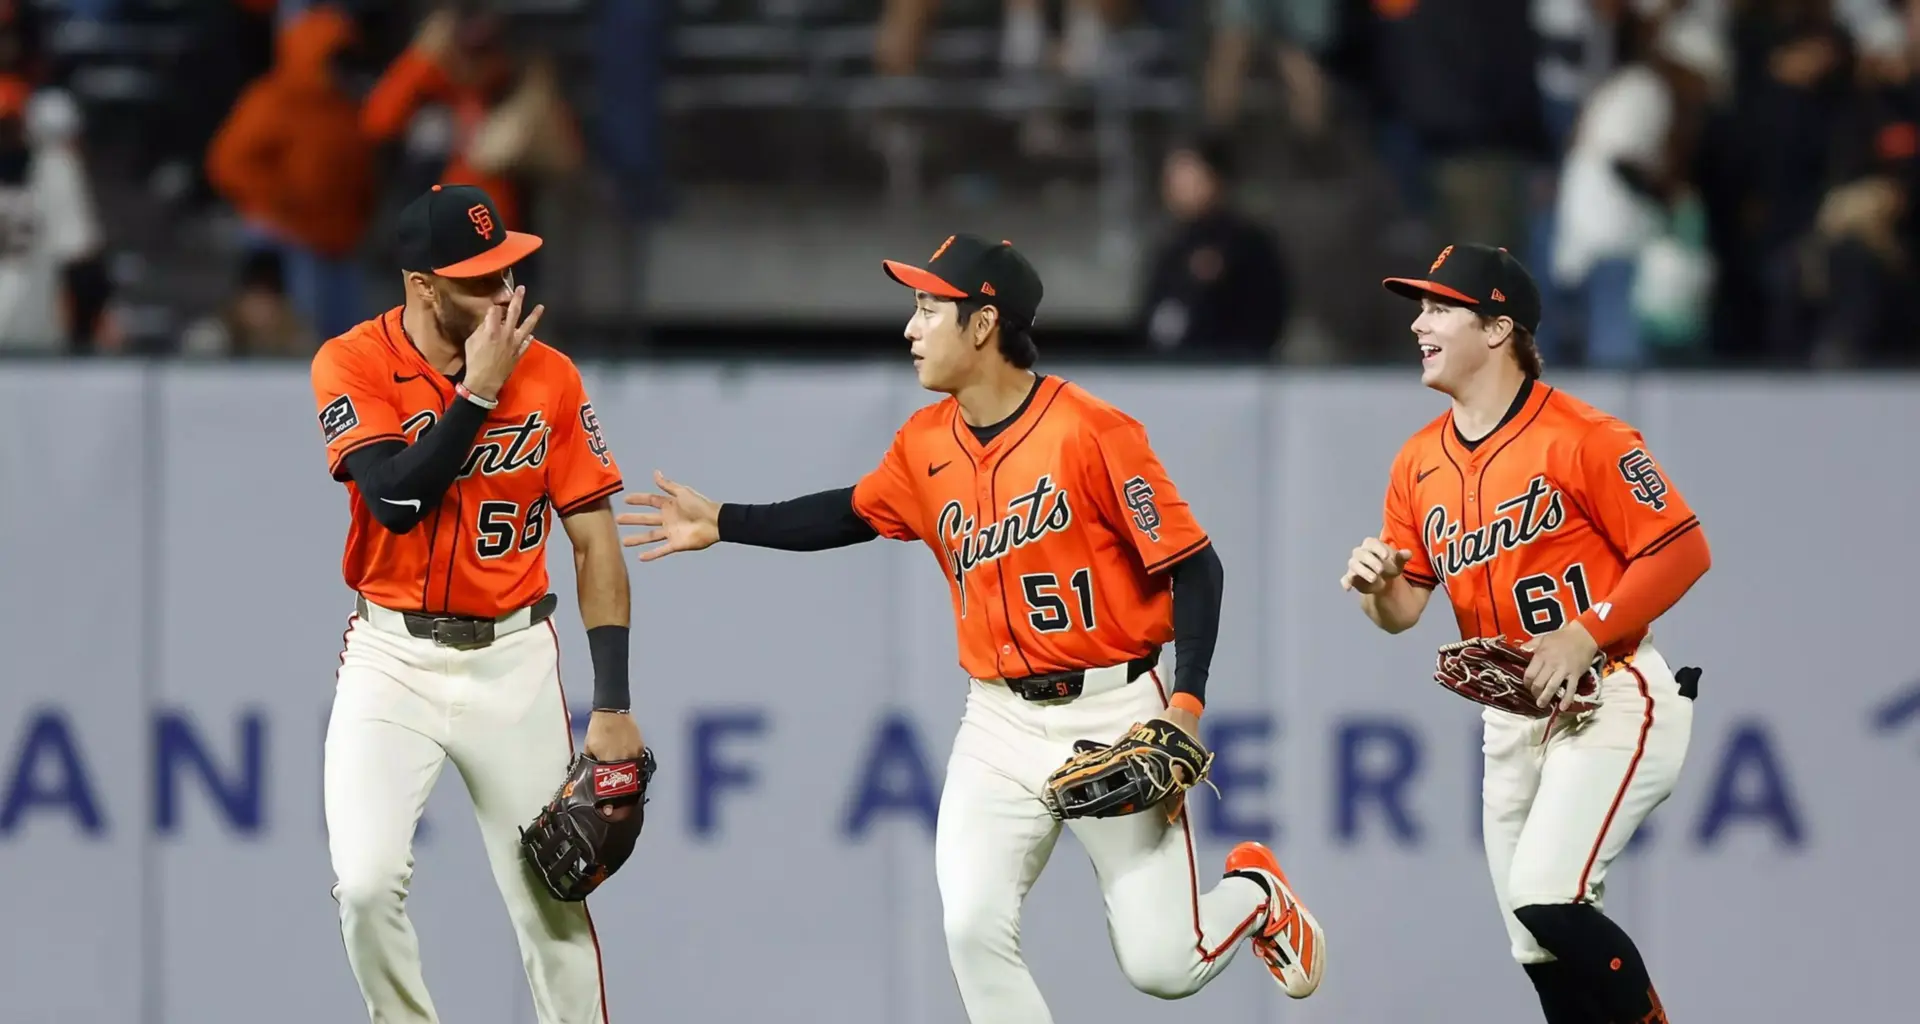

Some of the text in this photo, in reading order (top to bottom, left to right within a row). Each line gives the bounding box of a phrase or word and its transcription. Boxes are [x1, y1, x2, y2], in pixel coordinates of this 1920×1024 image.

[467, 203, 494, 240] SF
[401, 409, 552, 480] nts
[1122, 474, 1162, 543] SF
[1616, 447, 1669, 513] SF
[475, 493, 549, 560] 58
[937, 473, 1072, 619] Giants
[1423, 472, 1566, 590] Giants
[1019, 566, 1097, 634] 51
[1512, 562, 1593, 637] 61
[1055, 682, 1069, 696] 51
[0, 703, 424, 842] AN
[841, 706, 1808, 853] AERA
